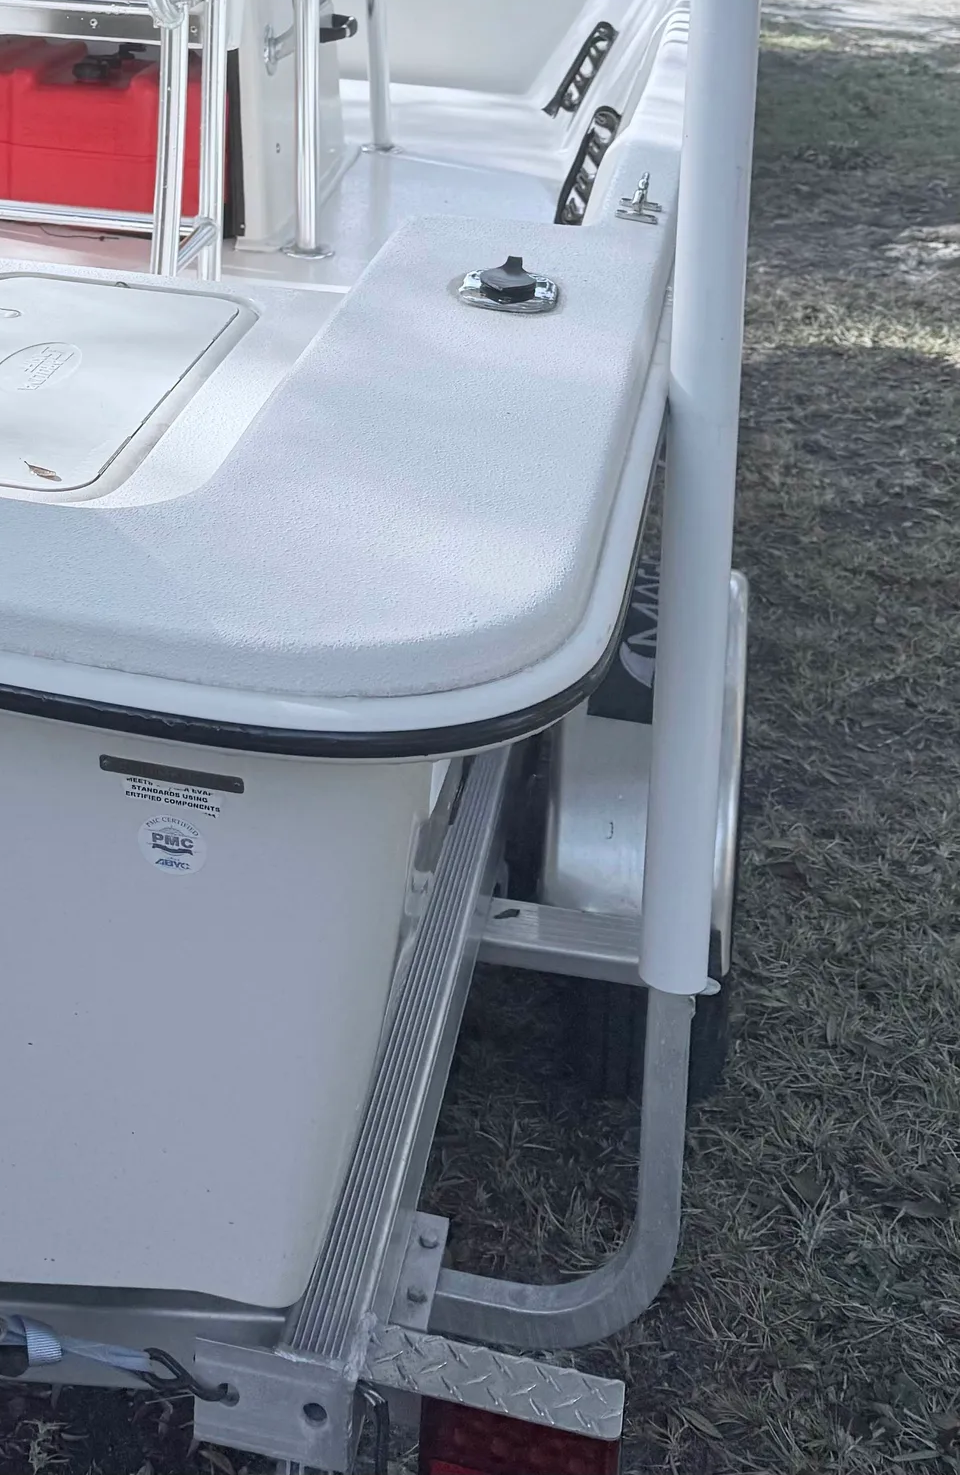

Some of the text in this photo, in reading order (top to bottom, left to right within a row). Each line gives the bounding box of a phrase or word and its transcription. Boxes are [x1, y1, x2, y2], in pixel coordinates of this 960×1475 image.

[125, 790, 221, 813] ERTIFIED COMPONENTS
[131, 784, 181, 798] STANDARDS
[182, 793, 209, 804] USING
[161, 816, 199, 837] CERTIFIED
[151, 832, 195, 849] PMC
